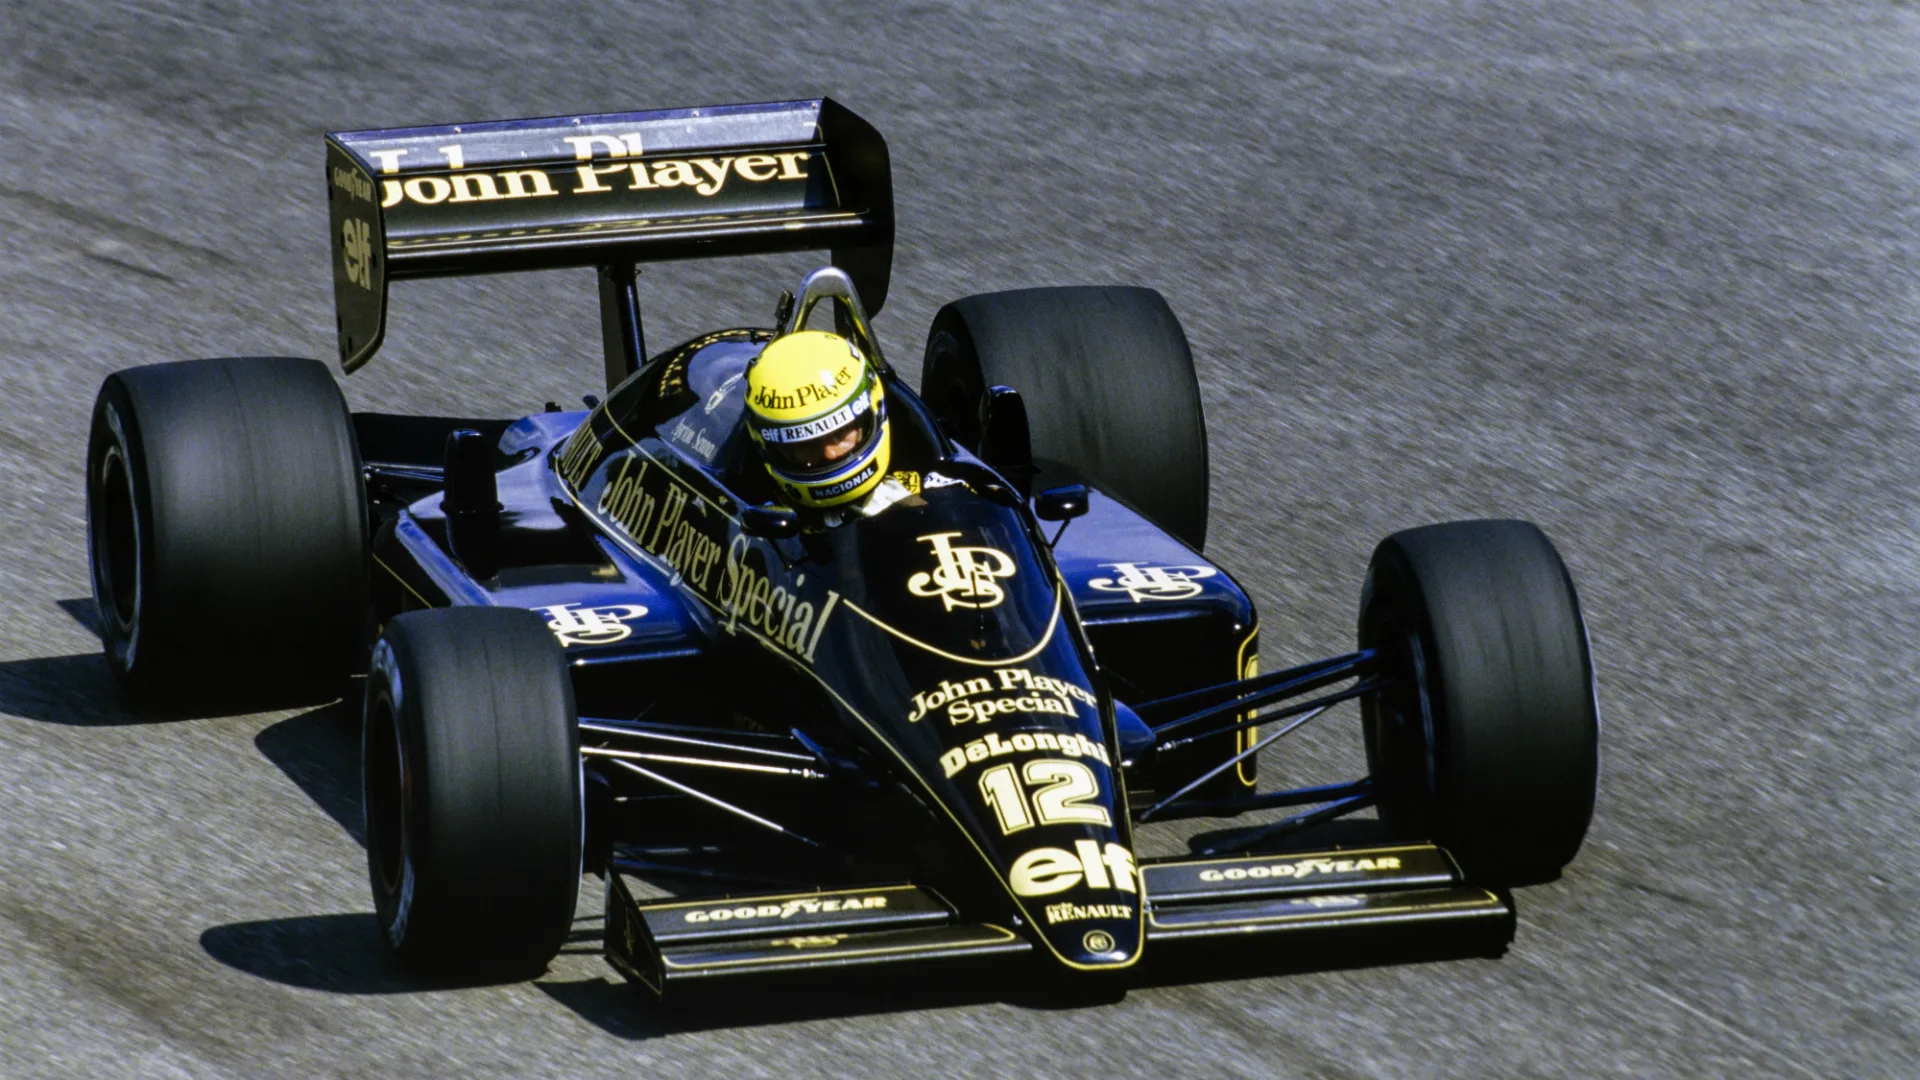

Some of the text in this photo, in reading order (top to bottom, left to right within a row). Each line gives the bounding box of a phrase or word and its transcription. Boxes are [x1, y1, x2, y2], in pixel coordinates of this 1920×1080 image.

[371, 131, 809, 208] John Player
[343, 218, 371, 291] elf
[754, 386, 795, 410] John
[796, 367, 852, 408] Player
[851, 391, 871, 417] elf
[761, 411, 848, 443] elf RENAULT
[814, 467, 875, 498] NACIONAL
[597, 449, 655, 543] John
[645, 482, 722, 593] Player
[716, 533, 840, 664] Special
[908, 669, 1097, 723] John Player
[948, 691, 1079, 726] Special
[978, 758, 1113, 836] 12
[1009, 839, 1138, 897] elf
[1200, 857, 1402, 882] GOODYEAR
[685, 896, 887, 924] GOODYEAR
[1045, 905, 1133, 925] RENAULT
